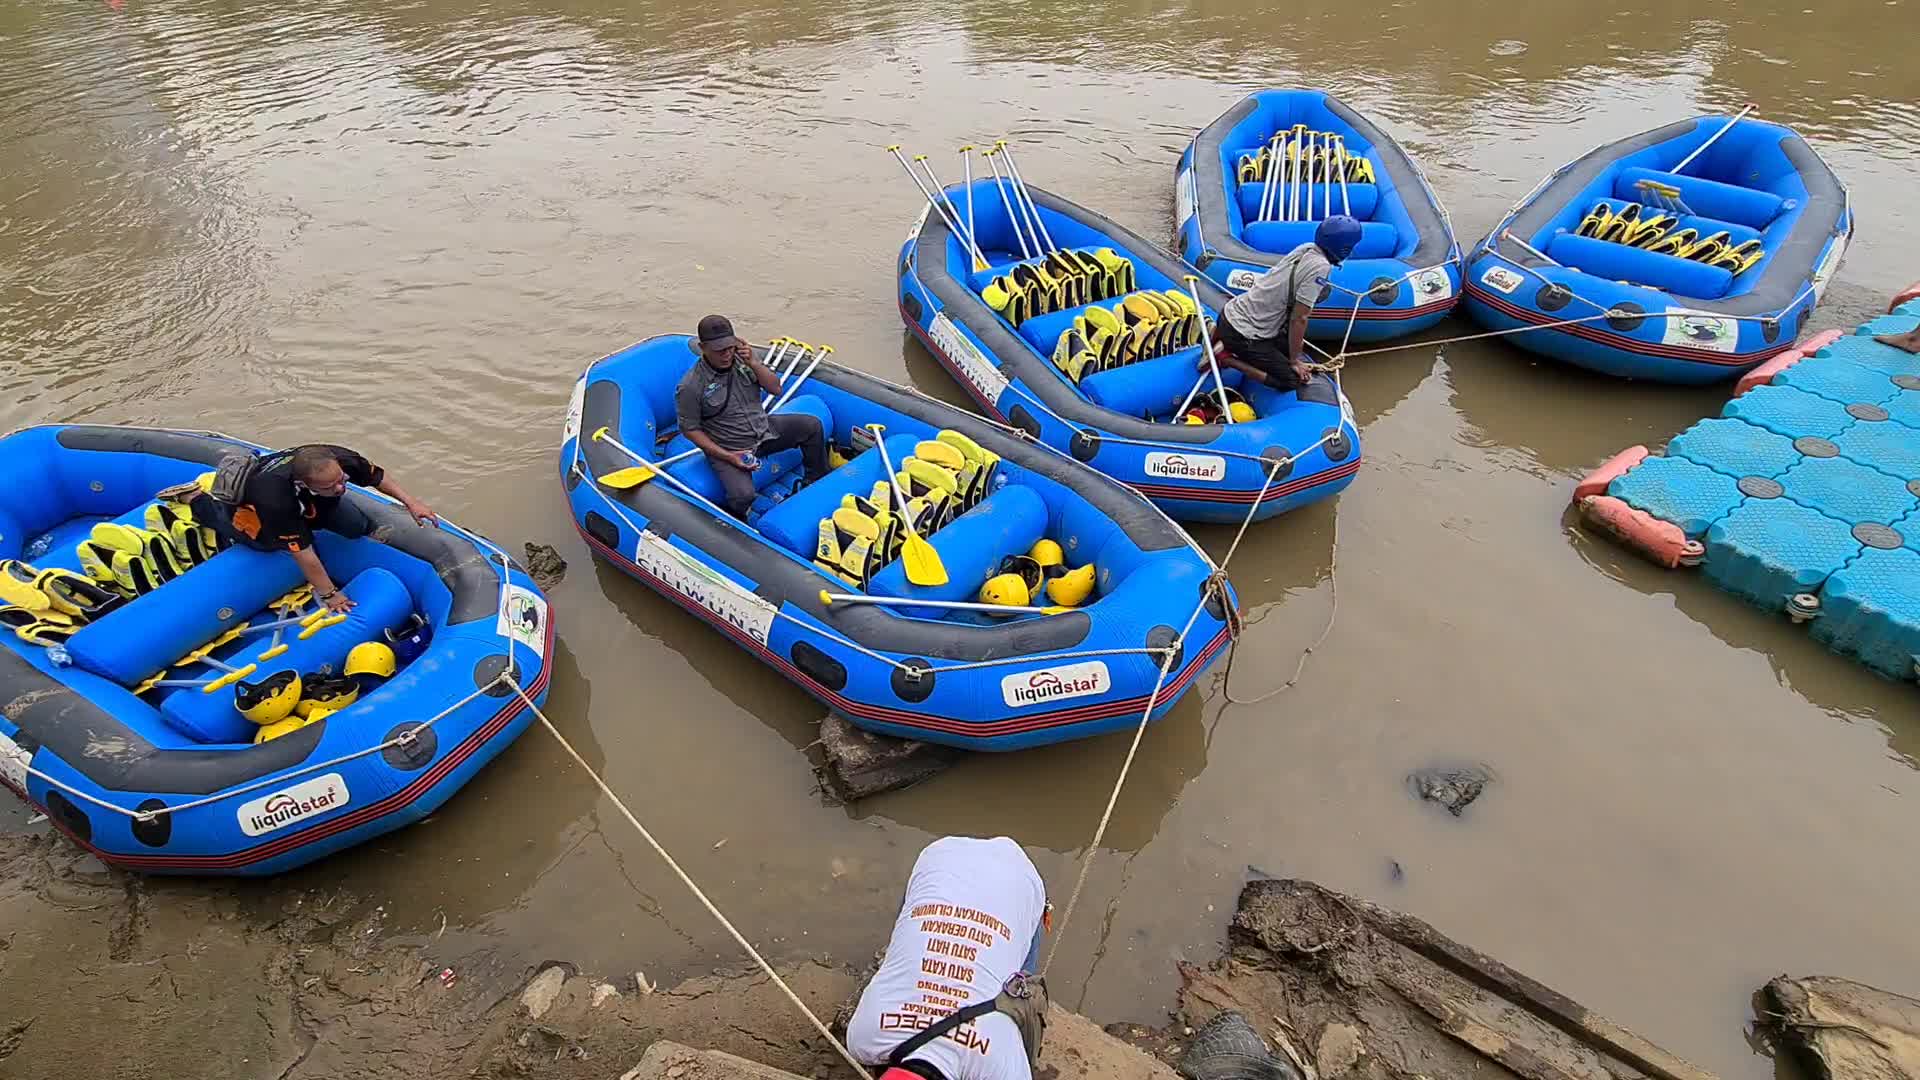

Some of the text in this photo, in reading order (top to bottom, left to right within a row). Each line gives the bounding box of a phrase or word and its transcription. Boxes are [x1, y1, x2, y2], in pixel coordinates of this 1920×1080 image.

[1153, 462, 1216, 476] liquidstar
[638, 558, 765, 643] CILIWUNG
[640, 549, 767, 631] SEKOLAH SUNGAI
[1014, 679, 1098, 701] liquidstar
[251, 793, 336, 831] liquidstar
[921, 920, 993, 947] SATU GERAKAN
[927, 938, 977, 961] SATU HATI
[922, 957, 974, 983] SATU KATA
[917, 981, 969, 999] CILIWUNG
[923, 994, 959, 1008] PEDULI
